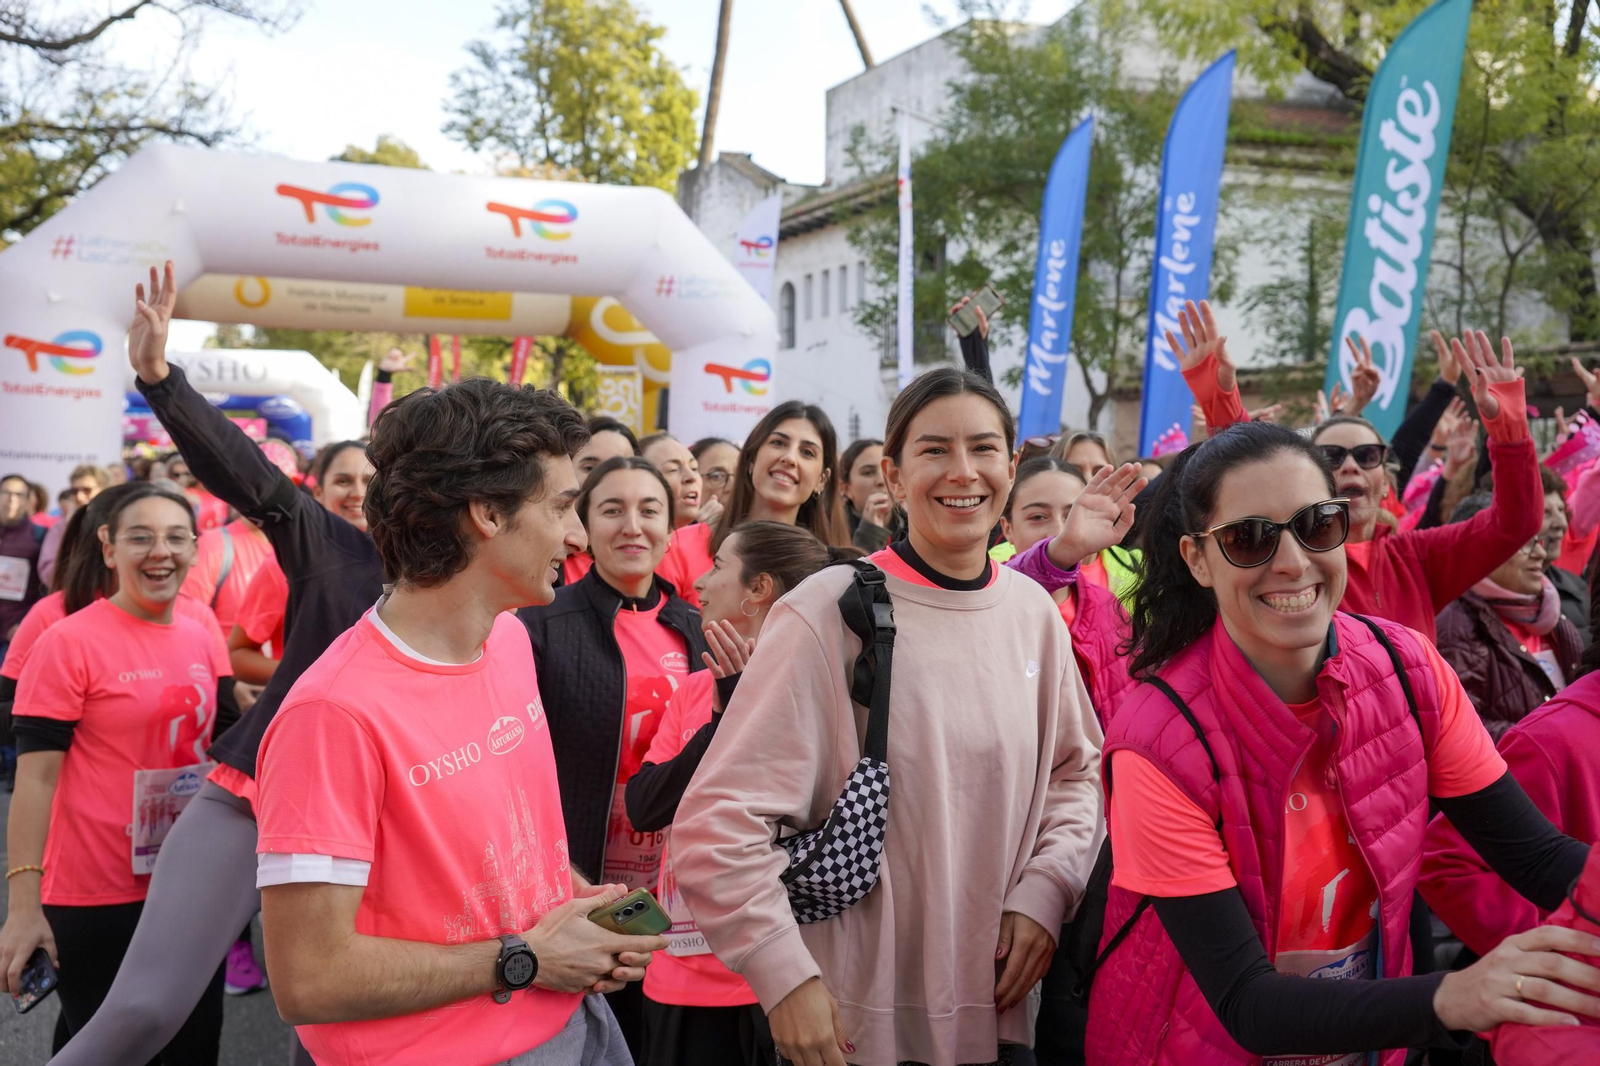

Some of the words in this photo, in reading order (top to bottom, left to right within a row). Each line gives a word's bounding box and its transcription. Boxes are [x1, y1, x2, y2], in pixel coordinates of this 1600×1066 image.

[276, 232, 380, 253] TotalEnergies
[1339, 80, 1440, 411] Batiste
[485, 246, 579, 266] TotalEnergies
[1153, 191, 1201, 371] Marlene
[1028, 239, 1067, 396] Marlene
[179, 360, 268, 382] YSHO
[1, 381, 102, 401] TotalEnergies
[119, 669, 162, 684] OYSHO
[491, 724, 523, 752] ASTURIANA
[408, 742, 481, 787] OYSHO
[670, 936, 705, 949] OYSHO
[1309, 1058, 1321, 1066] DE
[1322, 1054, 1332, 1063] LA
